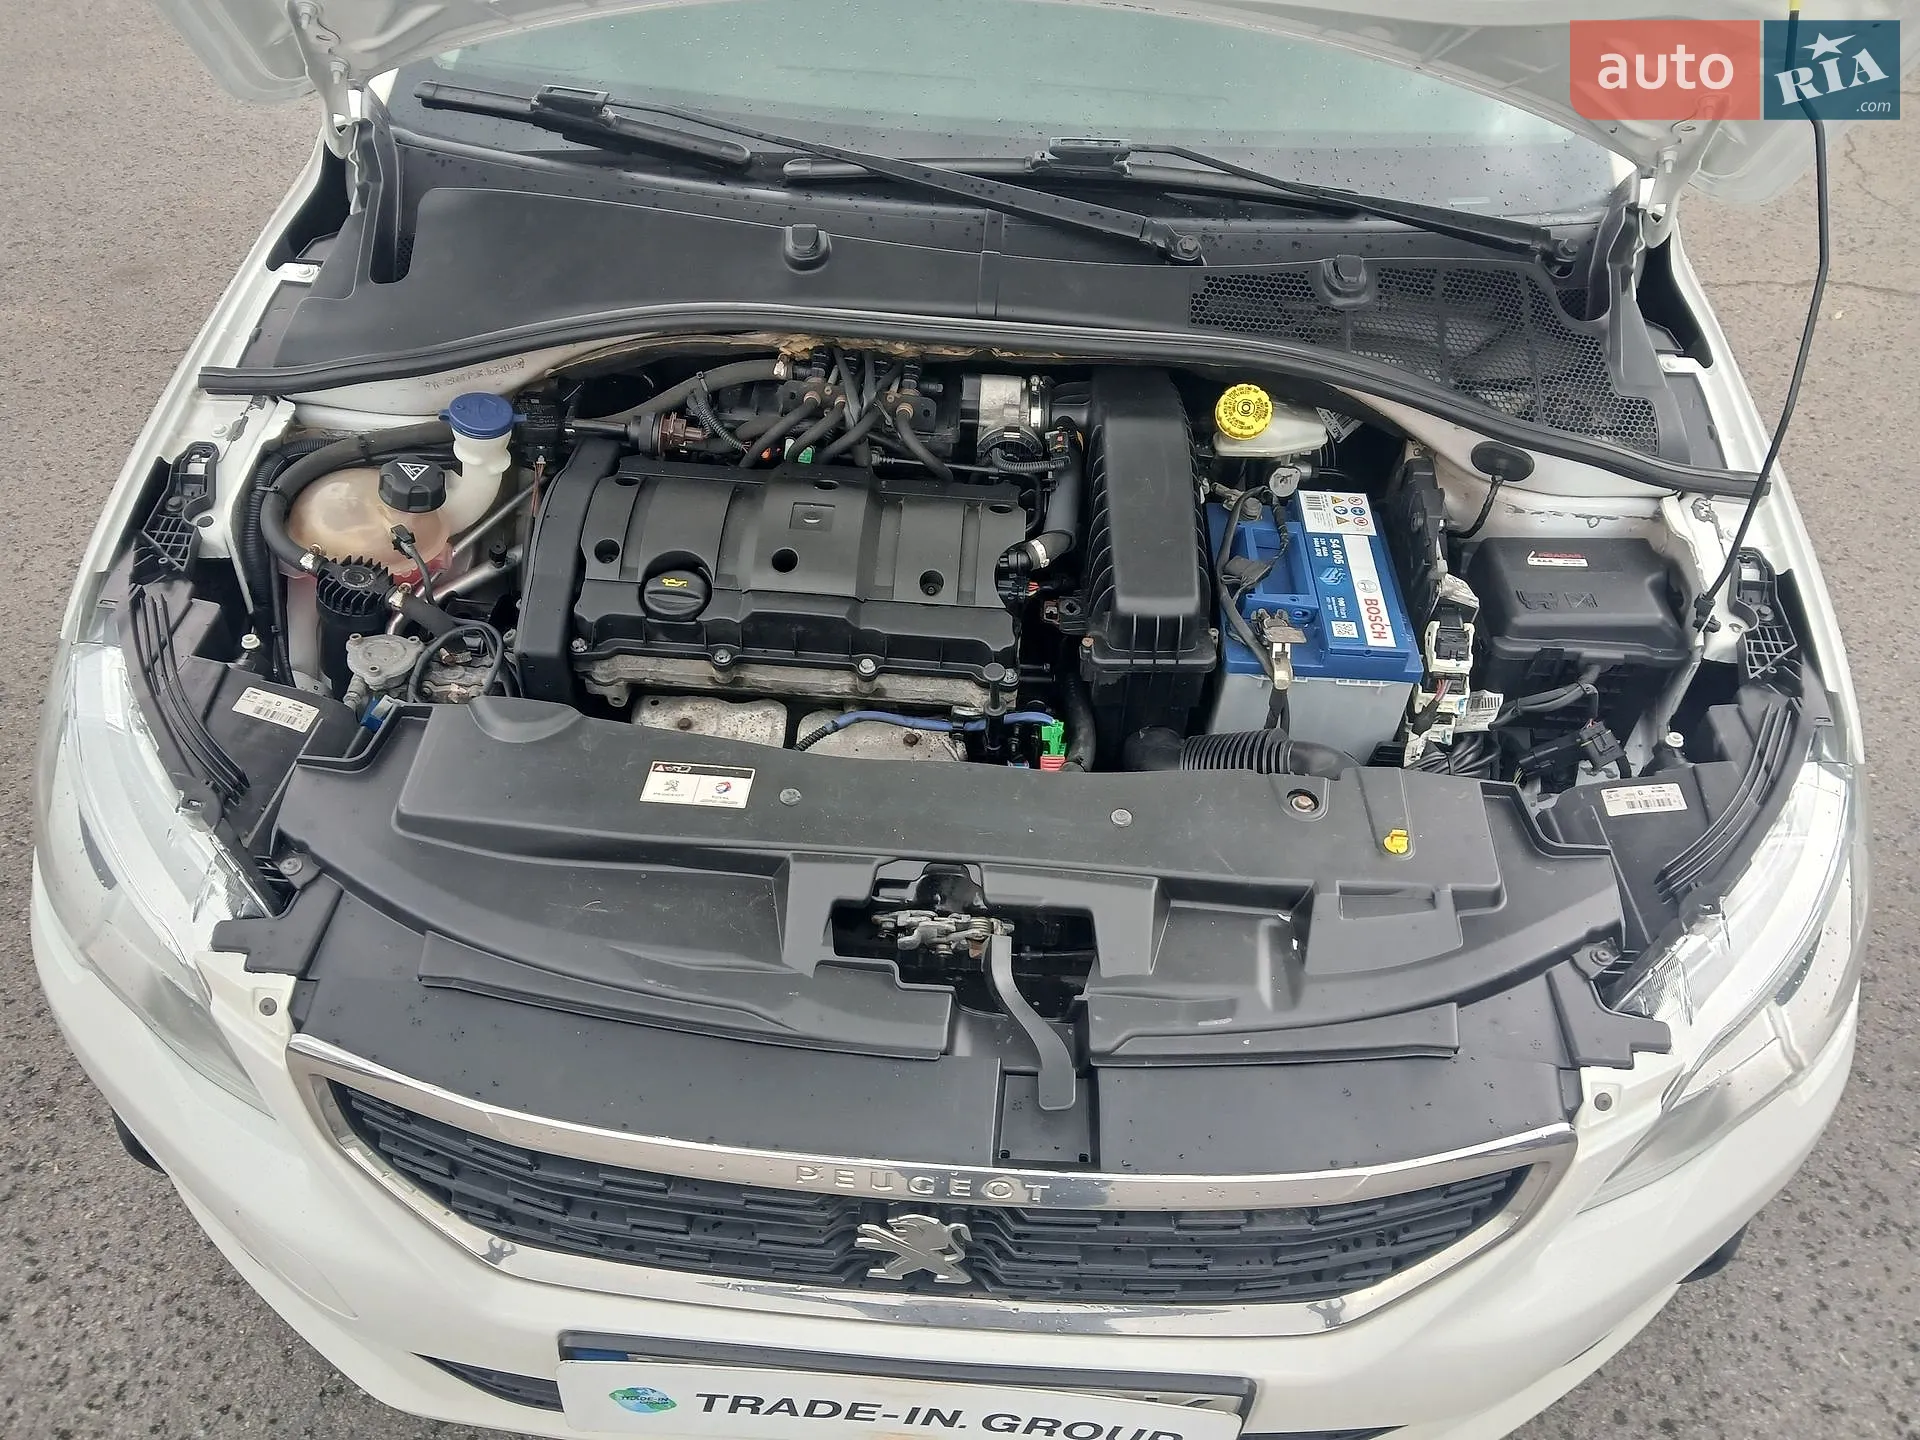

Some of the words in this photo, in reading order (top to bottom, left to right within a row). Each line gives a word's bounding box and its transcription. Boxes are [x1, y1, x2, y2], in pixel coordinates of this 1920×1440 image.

[1329, 538, 1342, 550] S4
[1332, 548, 1345, 565] 005
[1364, 598, 1387, 639] BOSCH
[797, 1165, 1050, 1202] PEUGEOT
[696, 1393, 967, 1429] TRADE-IN.
